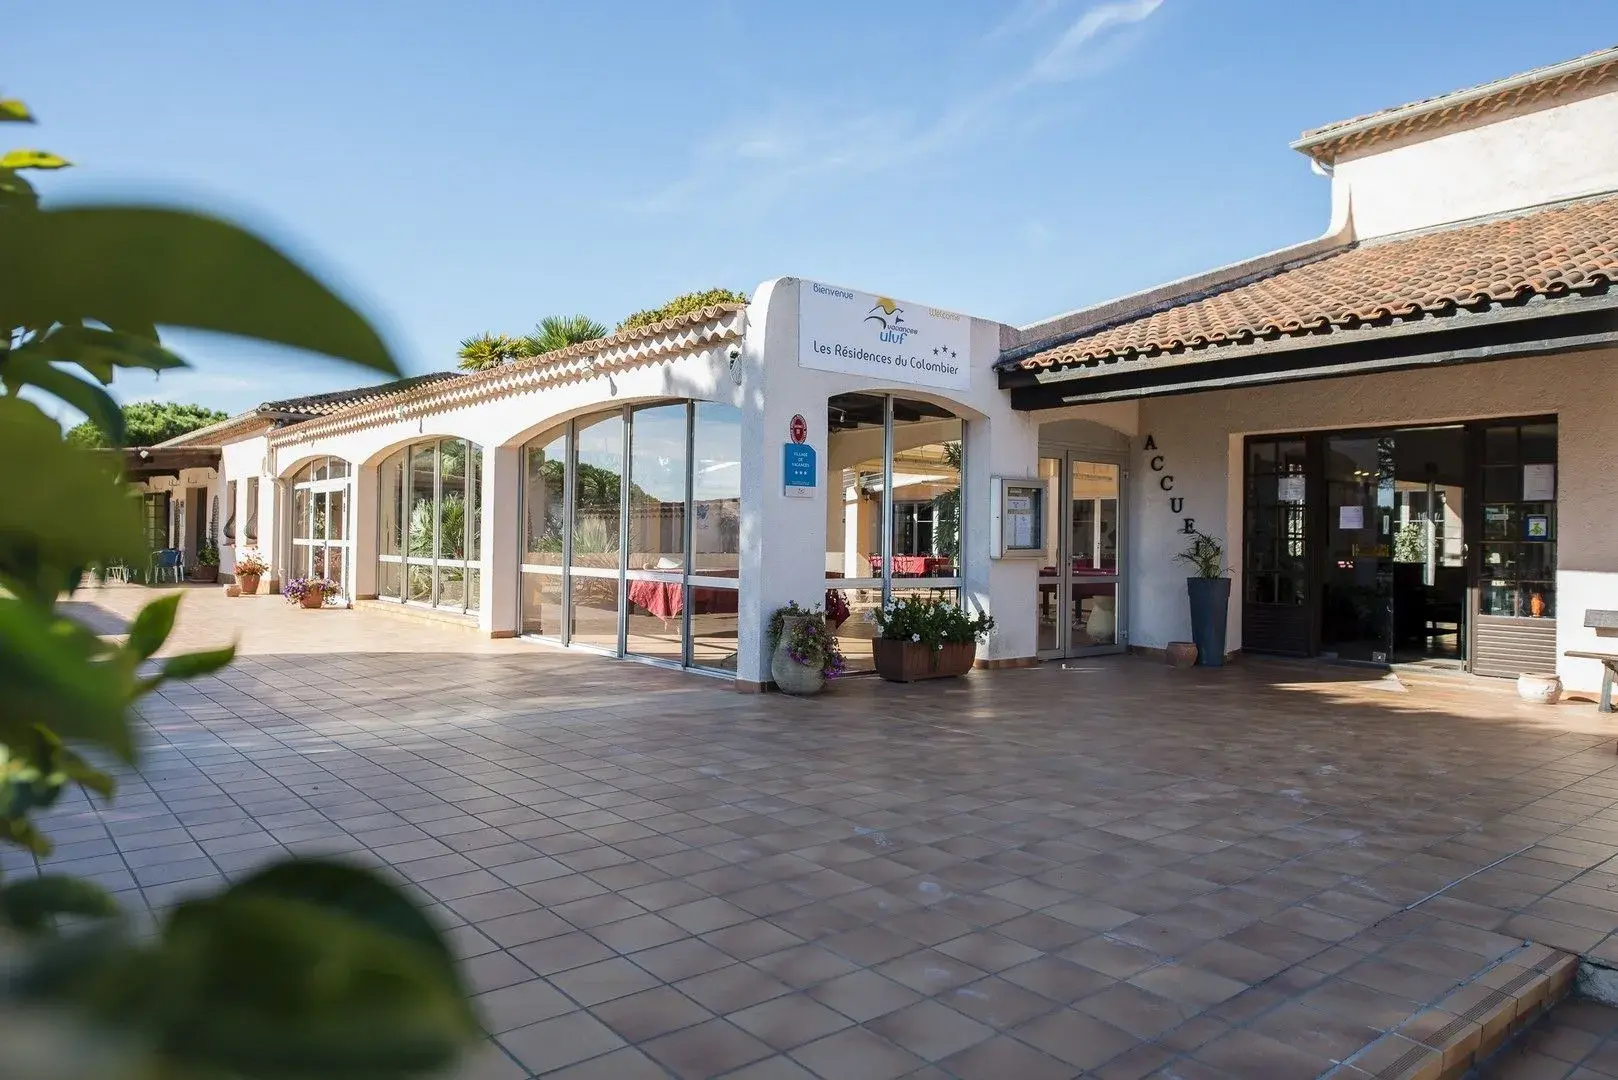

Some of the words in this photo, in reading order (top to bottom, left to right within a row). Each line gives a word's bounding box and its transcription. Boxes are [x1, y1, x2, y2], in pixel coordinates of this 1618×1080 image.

[813, 283, 854, 300] Bienvenue
[928, 308, 961, 322] Welcome
[813, 340, 832, 355] Les
[834, 344, 892, 364] Résidences
[894, 355, 908, 367] du
[910, 357, 959, 375] Colombier
[1143, 434, 1204, 557] ACCUEI
